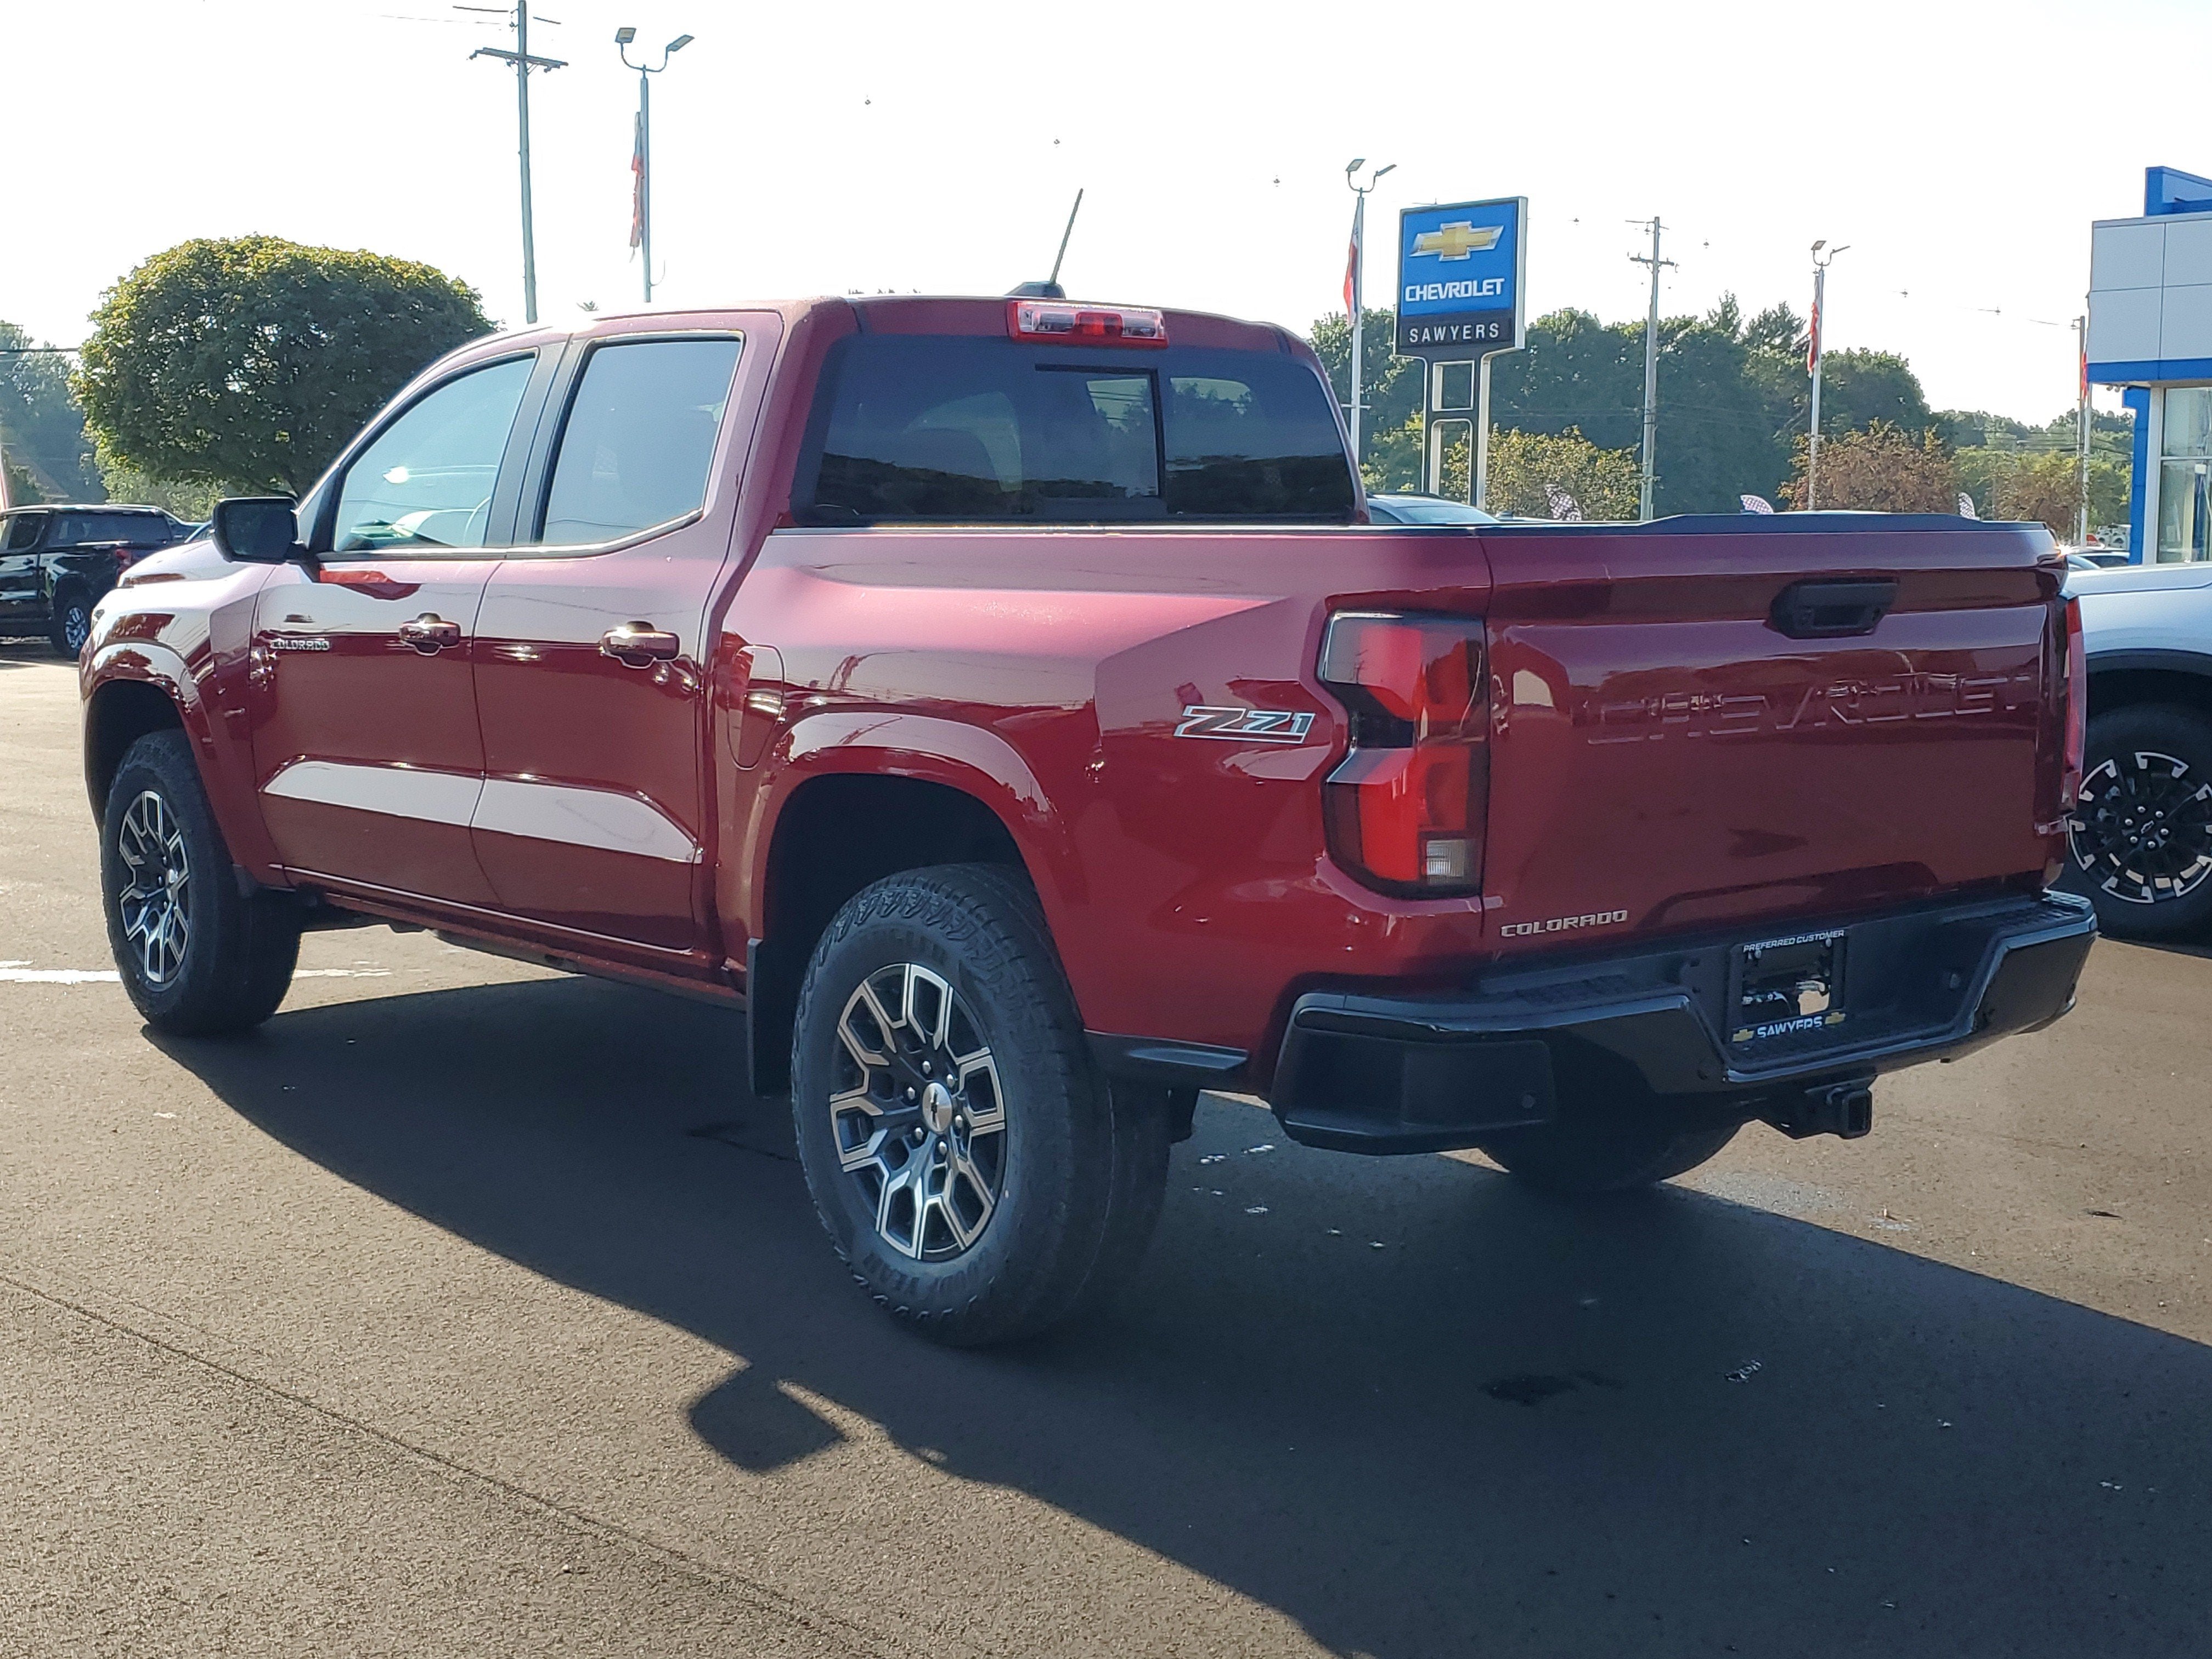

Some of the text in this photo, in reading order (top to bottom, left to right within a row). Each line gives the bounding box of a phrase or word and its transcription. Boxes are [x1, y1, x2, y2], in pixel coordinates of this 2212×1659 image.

[1405, 278, 1505, 301] CHEVROLET
[1409, 323, 1499, 343] SAWYERS
[270, 638, 329, 651] COLORADO
[1173, 704, 1316, 744] Z71
[1500, 910, 1628, 937] COLORADO
[1742, 929, 1844, 953] PREFERRED CUSTOMER
